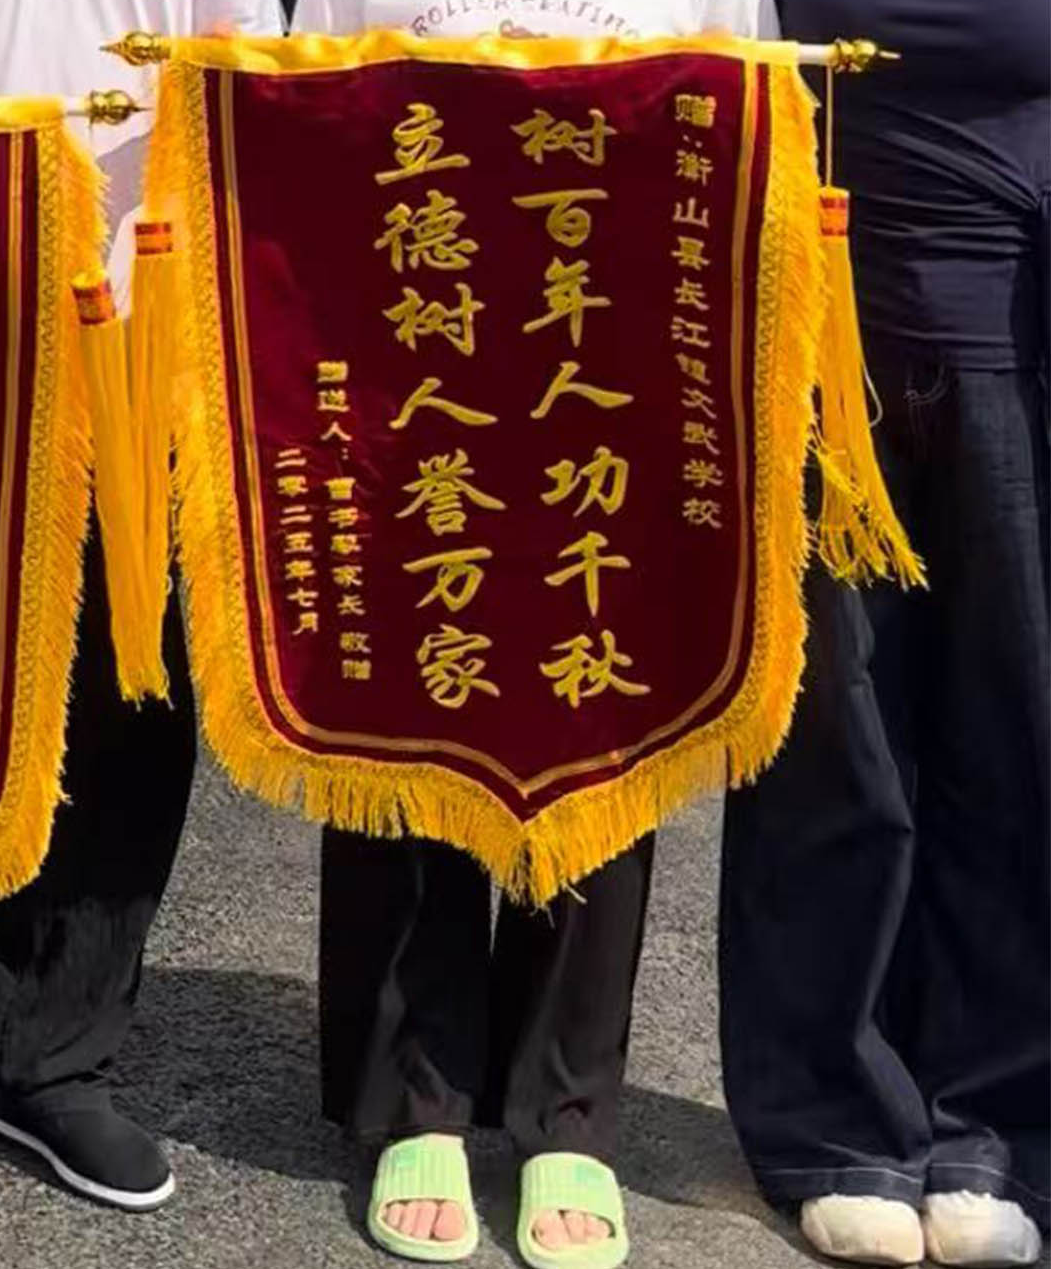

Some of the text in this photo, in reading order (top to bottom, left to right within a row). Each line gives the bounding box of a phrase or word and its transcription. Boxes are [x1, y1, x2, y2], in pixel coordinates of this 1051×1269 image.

[274, 448, 319, 635] 二零二五年七月
[373, 102, 507, 709] 立德树人誉万家
[509, 108, 651, 708] 树百年人功千秋
